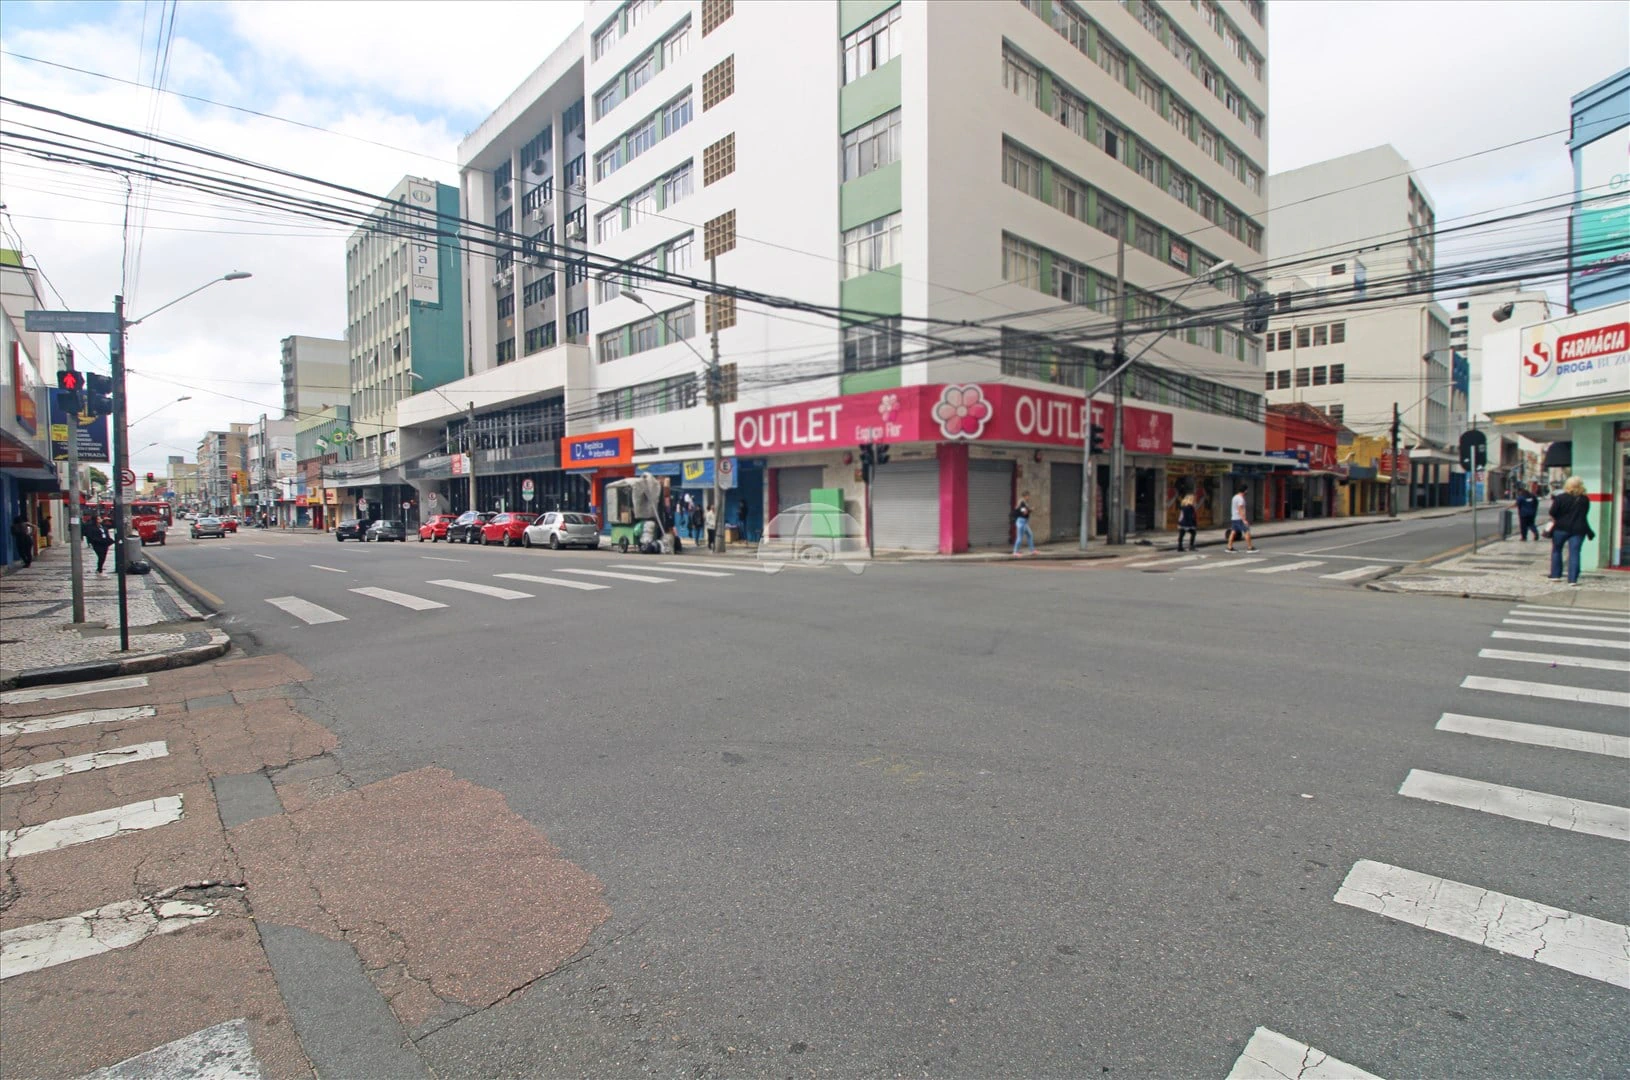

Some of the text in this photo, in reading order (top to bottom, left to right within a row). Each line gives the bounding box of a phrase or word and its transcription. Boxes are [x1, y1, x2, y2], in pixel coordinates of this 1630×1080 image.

[1560, 329, 1626, 360] FARMÁCIA
[1556, 360, 1593, 375] DROGA
[738, 404, 843, 448] OUTLET
[886, 422, 902, 438] Flor
